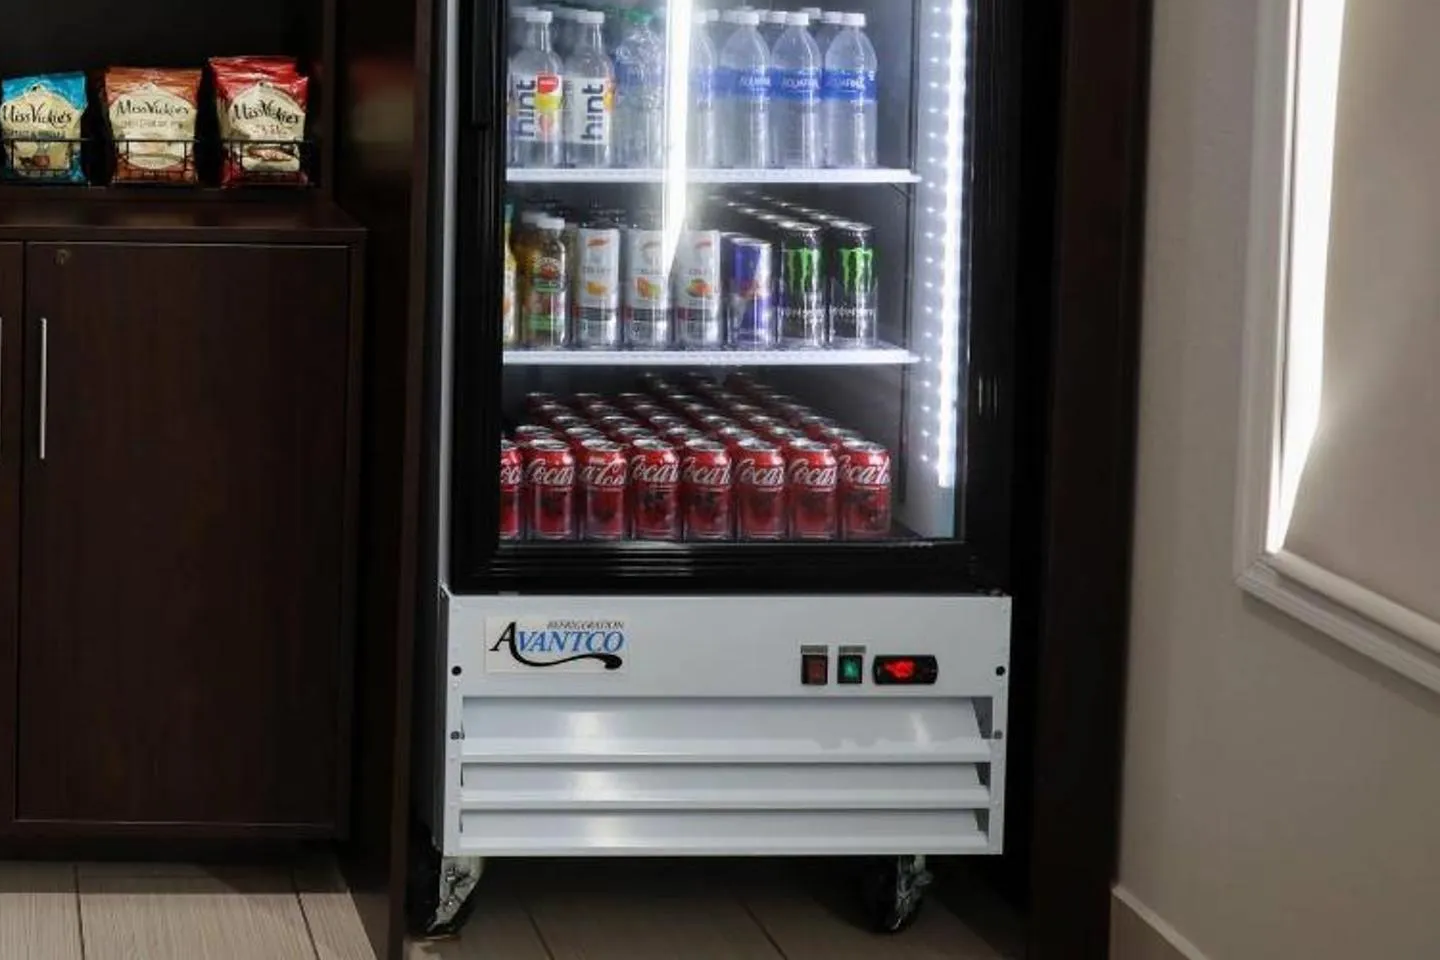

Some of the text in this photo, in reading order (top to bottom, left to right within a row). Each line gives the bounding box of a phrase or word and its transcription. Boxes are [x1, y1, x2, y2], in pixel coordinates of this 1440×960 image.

[516, 78, 536, 138] hint
[580, 83, 604, 141] hint
[489, 621, 624, 661] AVANTCO
